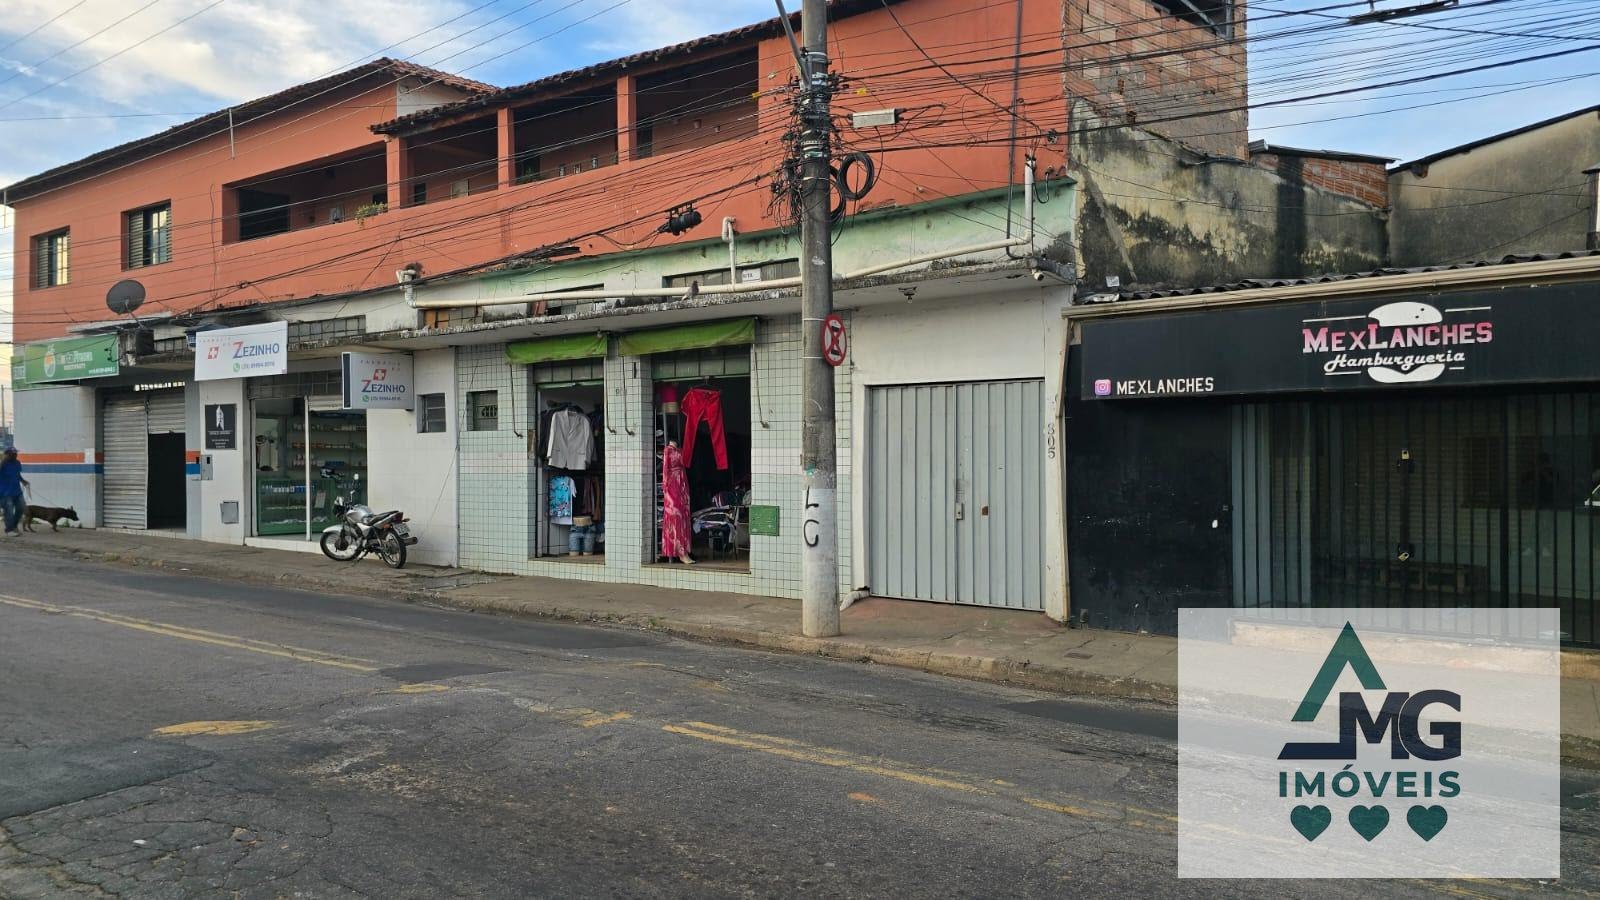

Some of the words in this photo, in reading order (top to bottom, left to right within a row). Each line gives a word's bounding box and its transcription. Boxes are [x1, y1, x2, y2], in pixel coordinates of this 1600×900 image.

[232, 340, 280, 359] ZEZINHO
[1323, 350, 1466, 372] Hamburgueria
[361, 379, 406, 393] ZEZINHO
[1116, 377, 1214, 395] MEXLANCHES
[1047, 423, 1056, 459] 305
